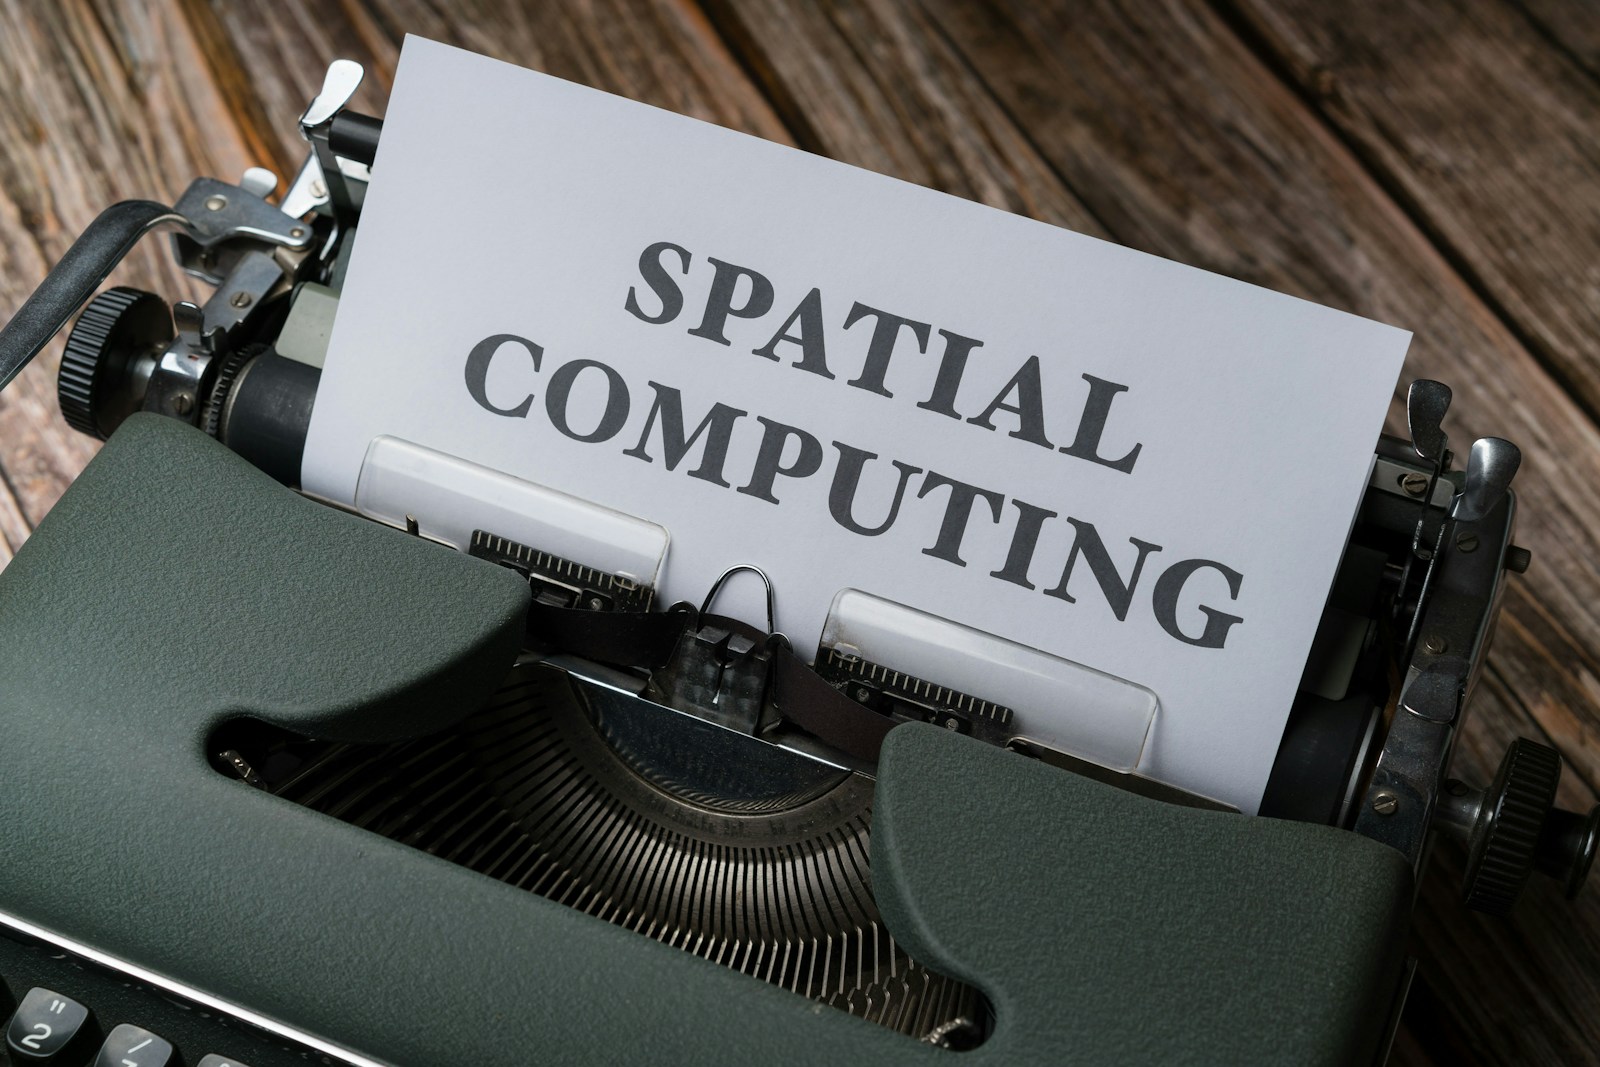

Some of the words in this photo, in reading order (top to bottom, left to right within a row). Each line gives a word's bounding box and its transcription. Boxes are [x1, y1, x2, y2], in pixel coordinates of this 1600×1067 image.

[624, 241, 1143, 475] SPATIAL
[464, 333, 1245, 650] COMPUTING
[21, 1023, 52, 1049] 2
